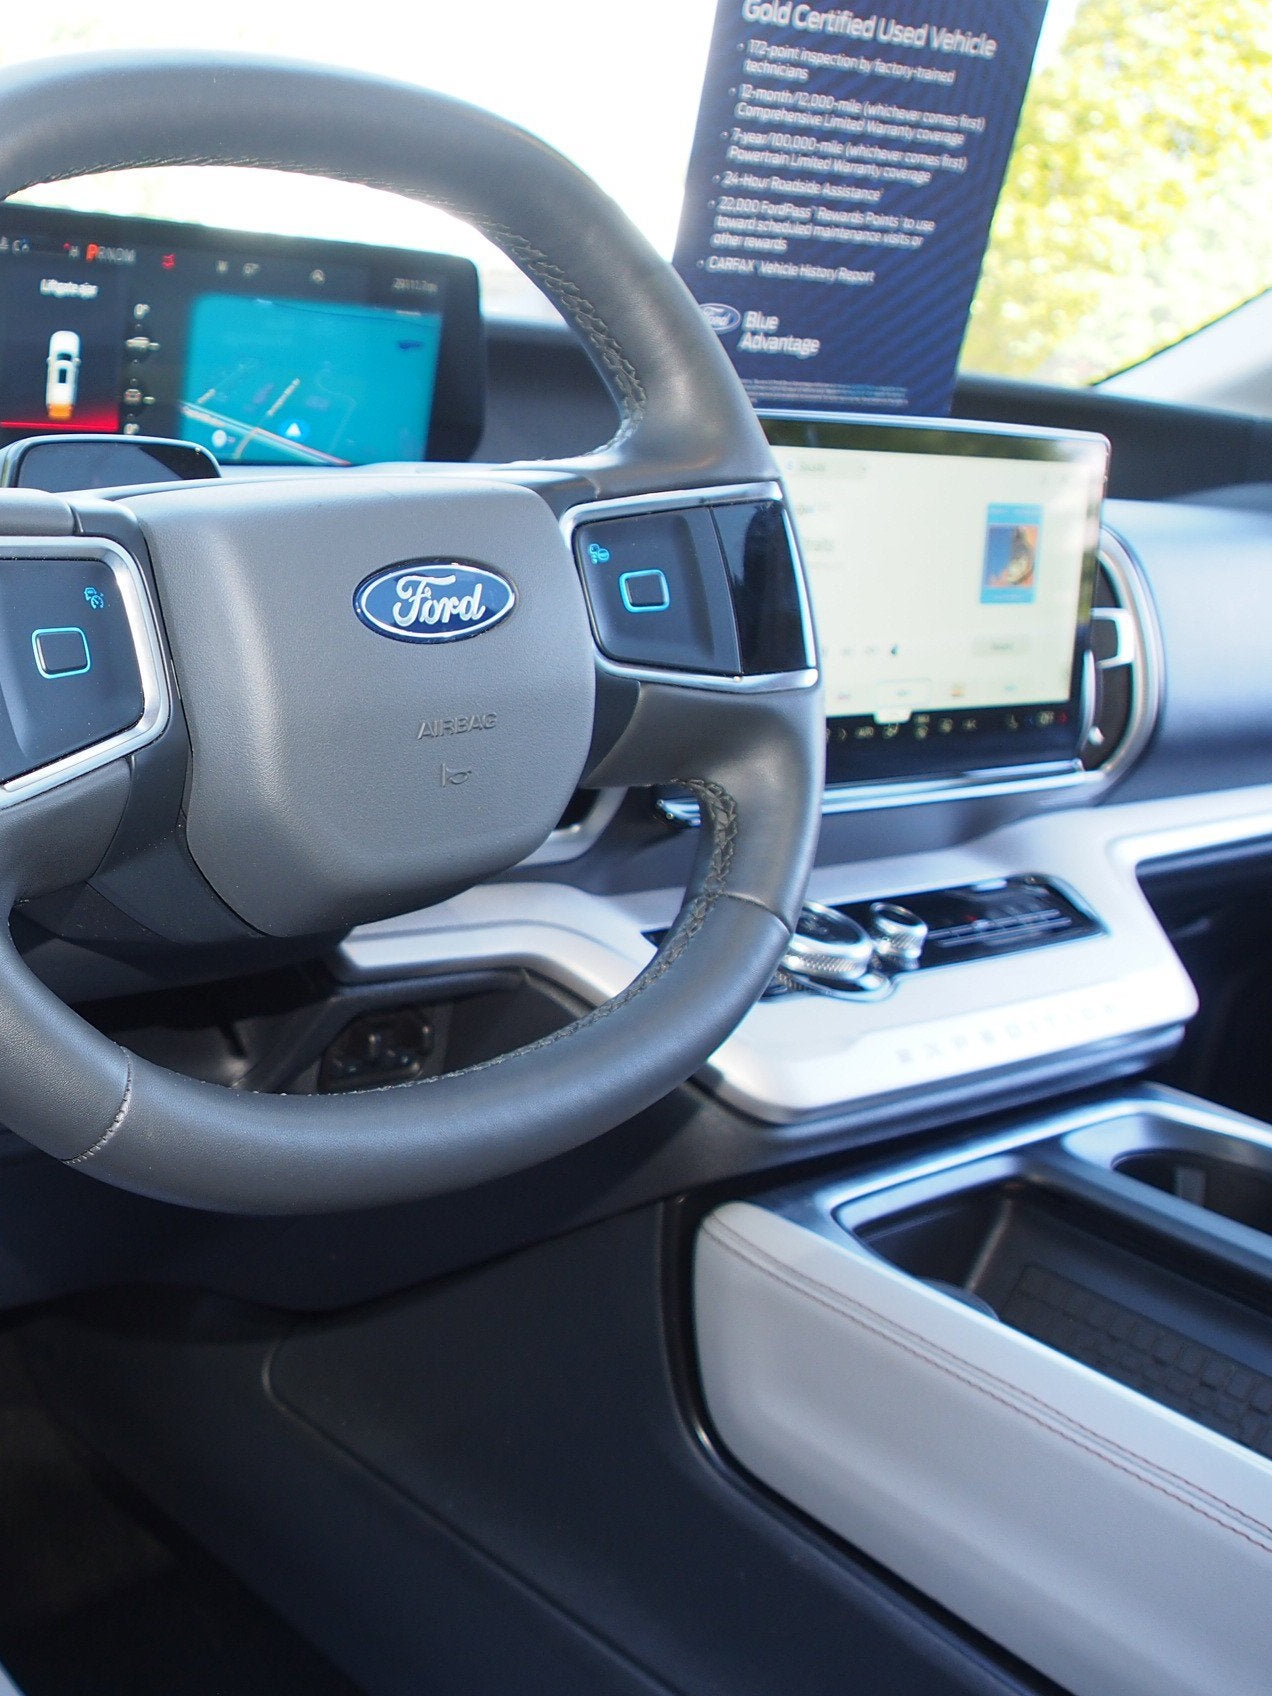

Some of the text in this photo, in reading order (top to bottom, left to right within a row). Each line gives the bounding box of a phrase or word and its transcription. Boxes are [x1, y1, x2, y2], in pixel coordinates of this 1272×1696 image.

[742, 0, 998, 57] Gold Certified Used Vehicle
[744, 59, 810, 80] technicians
[800, 47, 859, 68] inspection
[858, 56, 873, 72] by
[873, 58, 957, 83] factory-trained
[735, 101, 966, 146] Comprehensive Limited Warranty coverage
[922, 112, 959, 128] comes
[958, 114, 985, 132] first)
[728, 145, 933, 185] Powertrain Limited Warranty coverage
[904, 152, 940, 168] comes
[940, 154, 967, 174] first)
[770, 176, 822, 196] Roadside
[716, 214, 925, 249] toward scheduled maintenance visits or
[817, 206, 865, 226] Rewards
[902, 216, 916, 231] to
[916, 219, 936, 233] use
[713, 231, 789, 253] other rewards
[760, 260, 800, 278] Vehicle
[799, 264, 838, 282] History
[838, 266, 877, 285] Report
[744, 310, 779, 332] Blue
[741, 331, 821, 359] Advantage
[393, 575, 485, 626] Ford
[417, 712, 497, 740] AIRBAG
